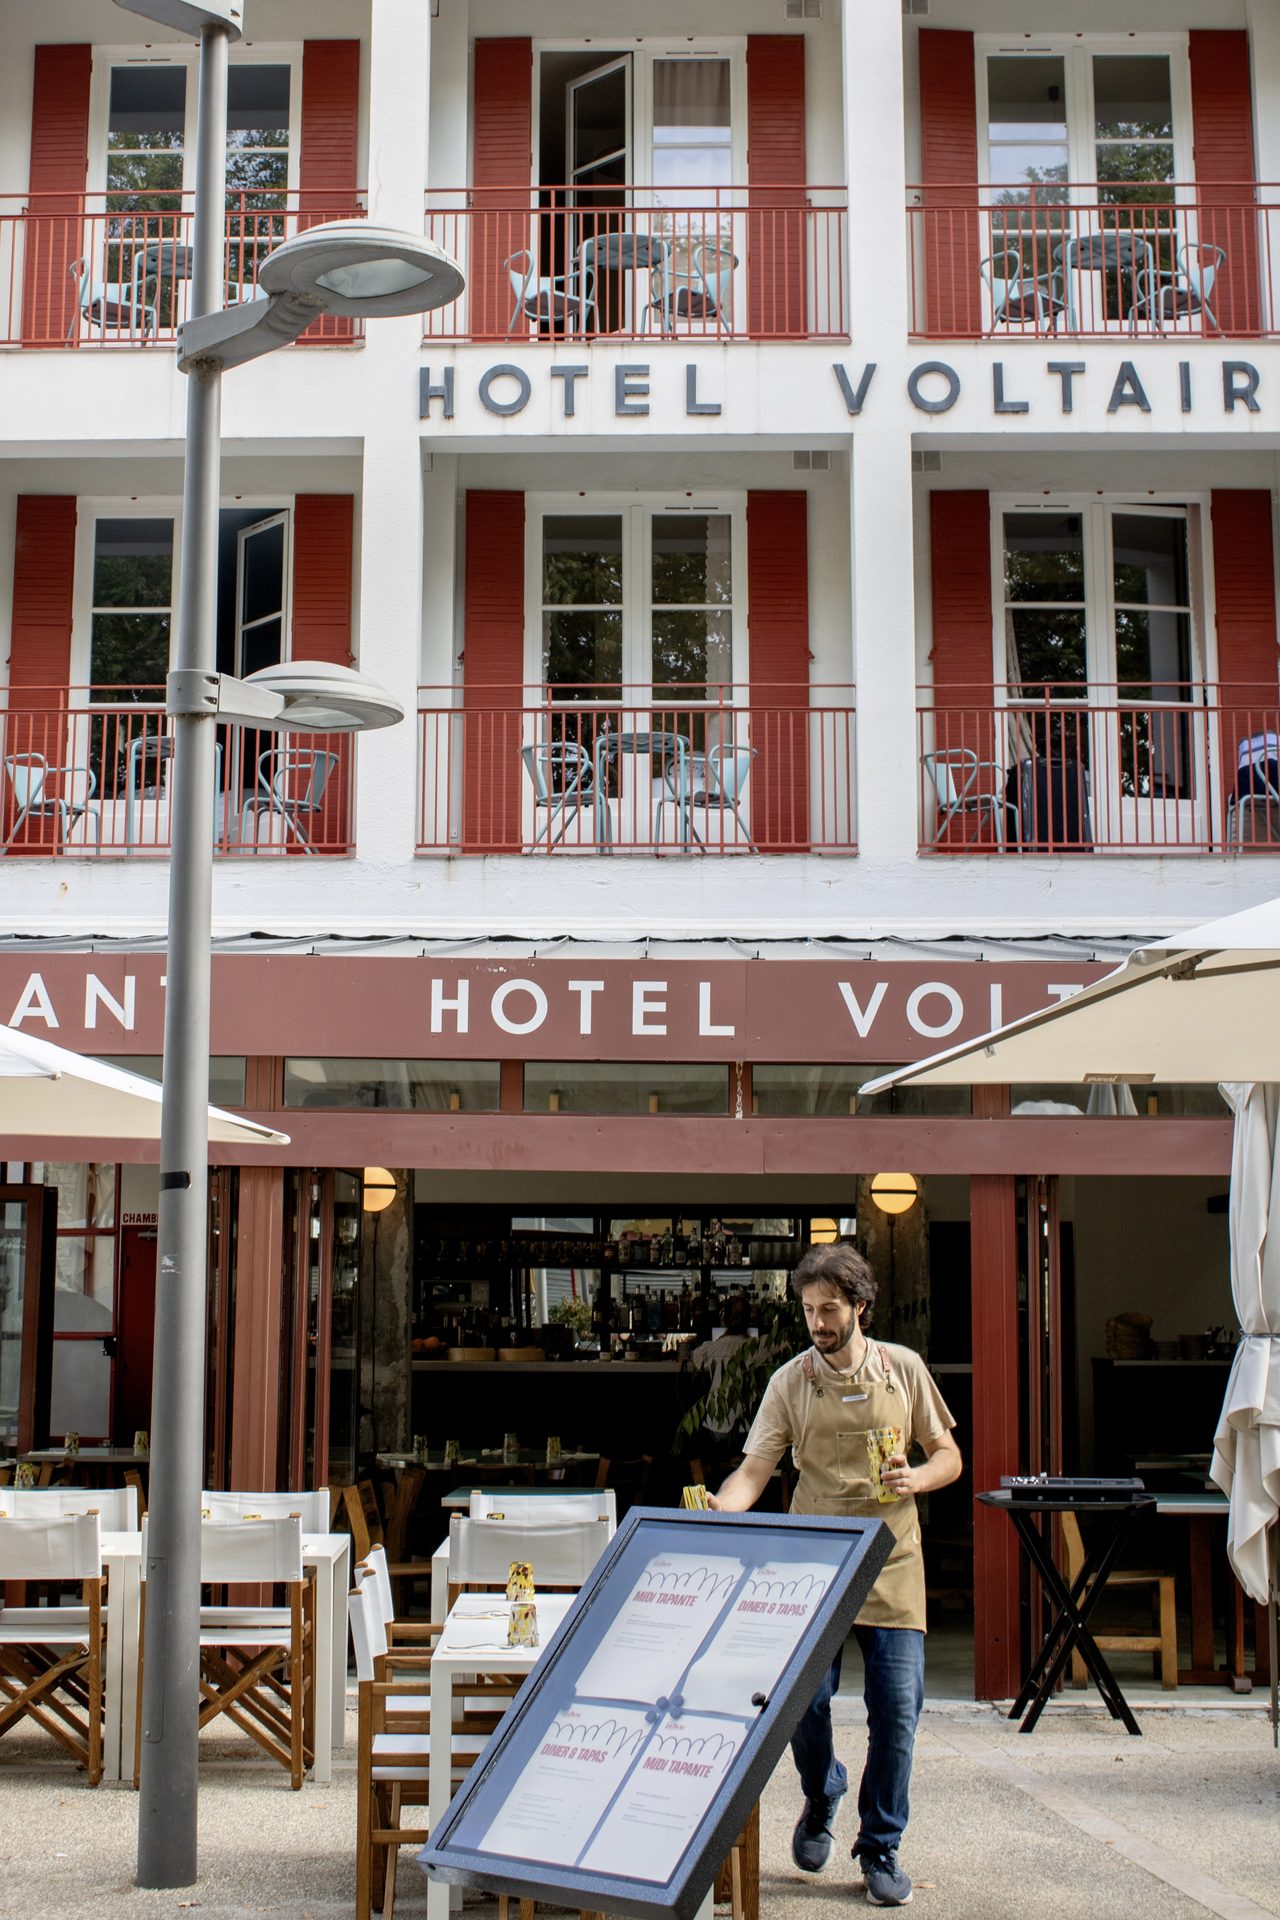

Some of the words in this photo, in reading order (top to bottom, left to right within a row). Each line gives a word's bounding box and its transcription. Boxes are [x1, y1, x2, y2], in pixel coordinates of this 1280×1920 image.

[419, 364, 722, 420] HOTEL
[832, 360, 1261, 416] VOLTAIR
[8, 972, 167, 1031] AN
[430, 978, 736, 1037] HOTEL
[122, 1213, 158, 1223] CHAMB
[632, 1591, 657, 1602] MIDI
[656, 1592, 699, 1607] TAPANTE
[737, 1600, 767, 1613] DINER
[776, 1604, 809, 1617] TAPAS
[540, 1743, 570, 1757] DINER
[576, 1747, 608, 1764] TAPAS
[642, 1756, 667, 1771] MIDI
[667, 1759, 714, 1779] TAPANTE
